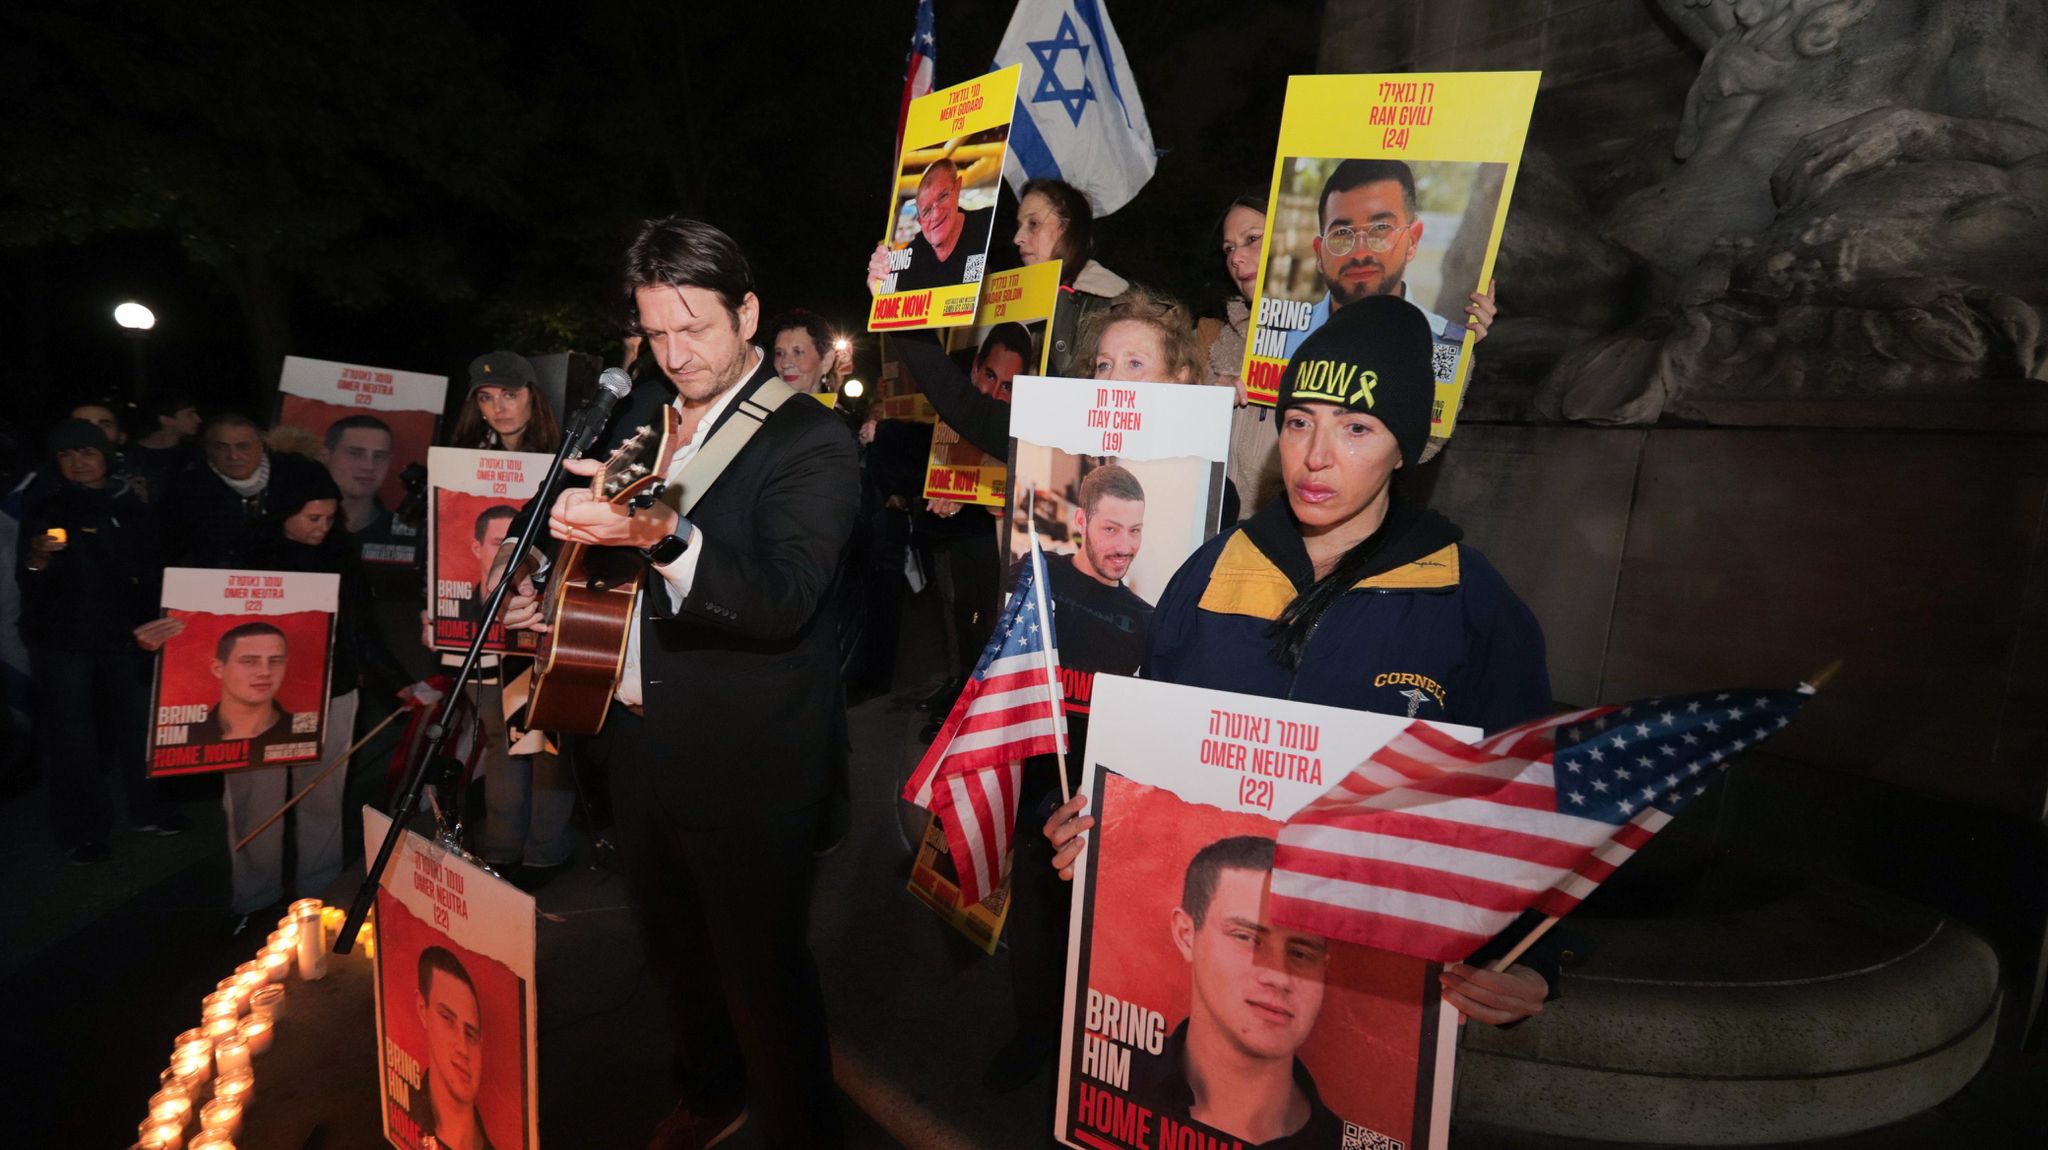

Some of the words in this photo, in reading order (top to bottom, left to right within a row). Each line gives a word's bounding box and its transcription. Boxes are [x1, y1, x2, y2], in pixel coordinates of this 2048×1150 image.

[1420, 82, 1435, 105] רן
[939, 105, 958, 121] MENY
[957, 96, 984, 116] GODARD
[1369, 106, 1397, 126] RAN
[1398, 106, 1433, 126] GVILI
[952, 116, 965, 133] (73)
[1382, 127, 1409, 150] (24)
[887, 247, 914, 272] RING
[873, 297, 902, 321] HOME
[901, 289, 933, 318] NOW!
[1257, 297, 1313, 332] BRING
[1253, 327, 1288, 360] HIM
[1247, 360, 1287, 391] HOM
[1293, 360, 1358, 397] NOW
[1096, 388, 1109, 409] חן
[1111, 389, 1136, 409] איתי
[1087, 409, 1111, 429] ITAY
[1112, 410, 1142, 431] CHEN
[1102, 430, 1123, 453] (19)
[477, 469, 496, 481] OMER
[497, 471, 525, 483] NEUTRA
[493, 482, 507, 494] (22)
[928, 469, 954, 490] HOME
[954, 468, 980, 493] NOW!
[438, 580, 473, 600] BRING
[437, 598, 460, 618] HIM
[437, 620, 470, 639] HOME
[157, 703, 209, 726] BRING
[1208, 709, 1272, 744] נאוטרה
[155, 724, 189, 746] HIM
[1275, 719, 1320, 752] עומר
[153, 745, 201, 769] HOME
[203, 738, 250, 763] NOW!
[1199, 738, 1248, 771] OMER
[1251, 747, 1323, 786] NEUTRA
[1238, 775, 1275, 812] (22)
[414, 871, 436, 901] OMER
[436, 884, 469, 920] NEUTRA
[433, 903, 450, 932] (22)
[1085, 987, 1166, 1056] BRING
[386, 1036, 422, 1091] BRING
[1081, 1032, 1131, 1092] HIM
[387, 1066, 410, 1112] HIM
[1078, 1080, 1152, 1150] HOME
[1158, 1115, 1244, 1150] NO
